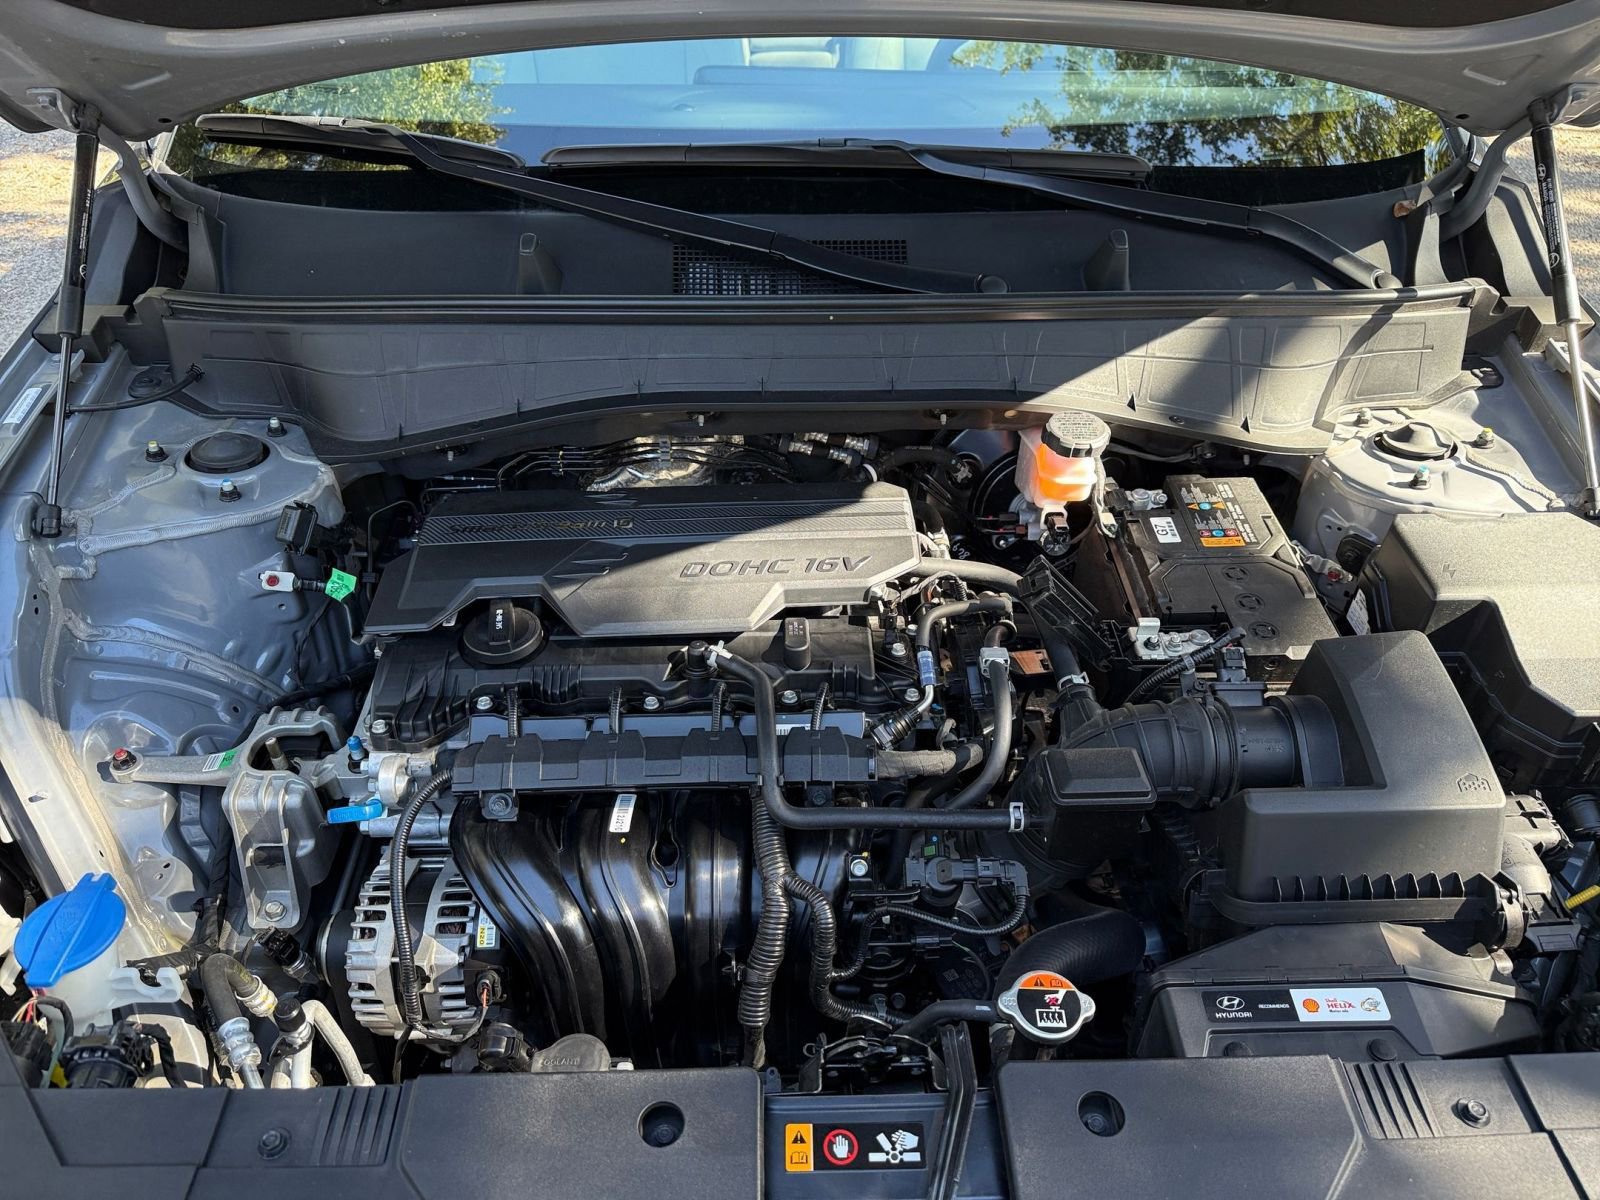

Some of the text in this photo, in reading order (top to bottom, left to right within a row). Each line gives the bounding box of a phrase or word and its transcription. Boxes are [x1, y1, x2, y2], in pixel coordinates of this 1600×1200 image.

[1155, 523, 1169, 536] G7
[679, 555, 872, 578] DOHC 16V
